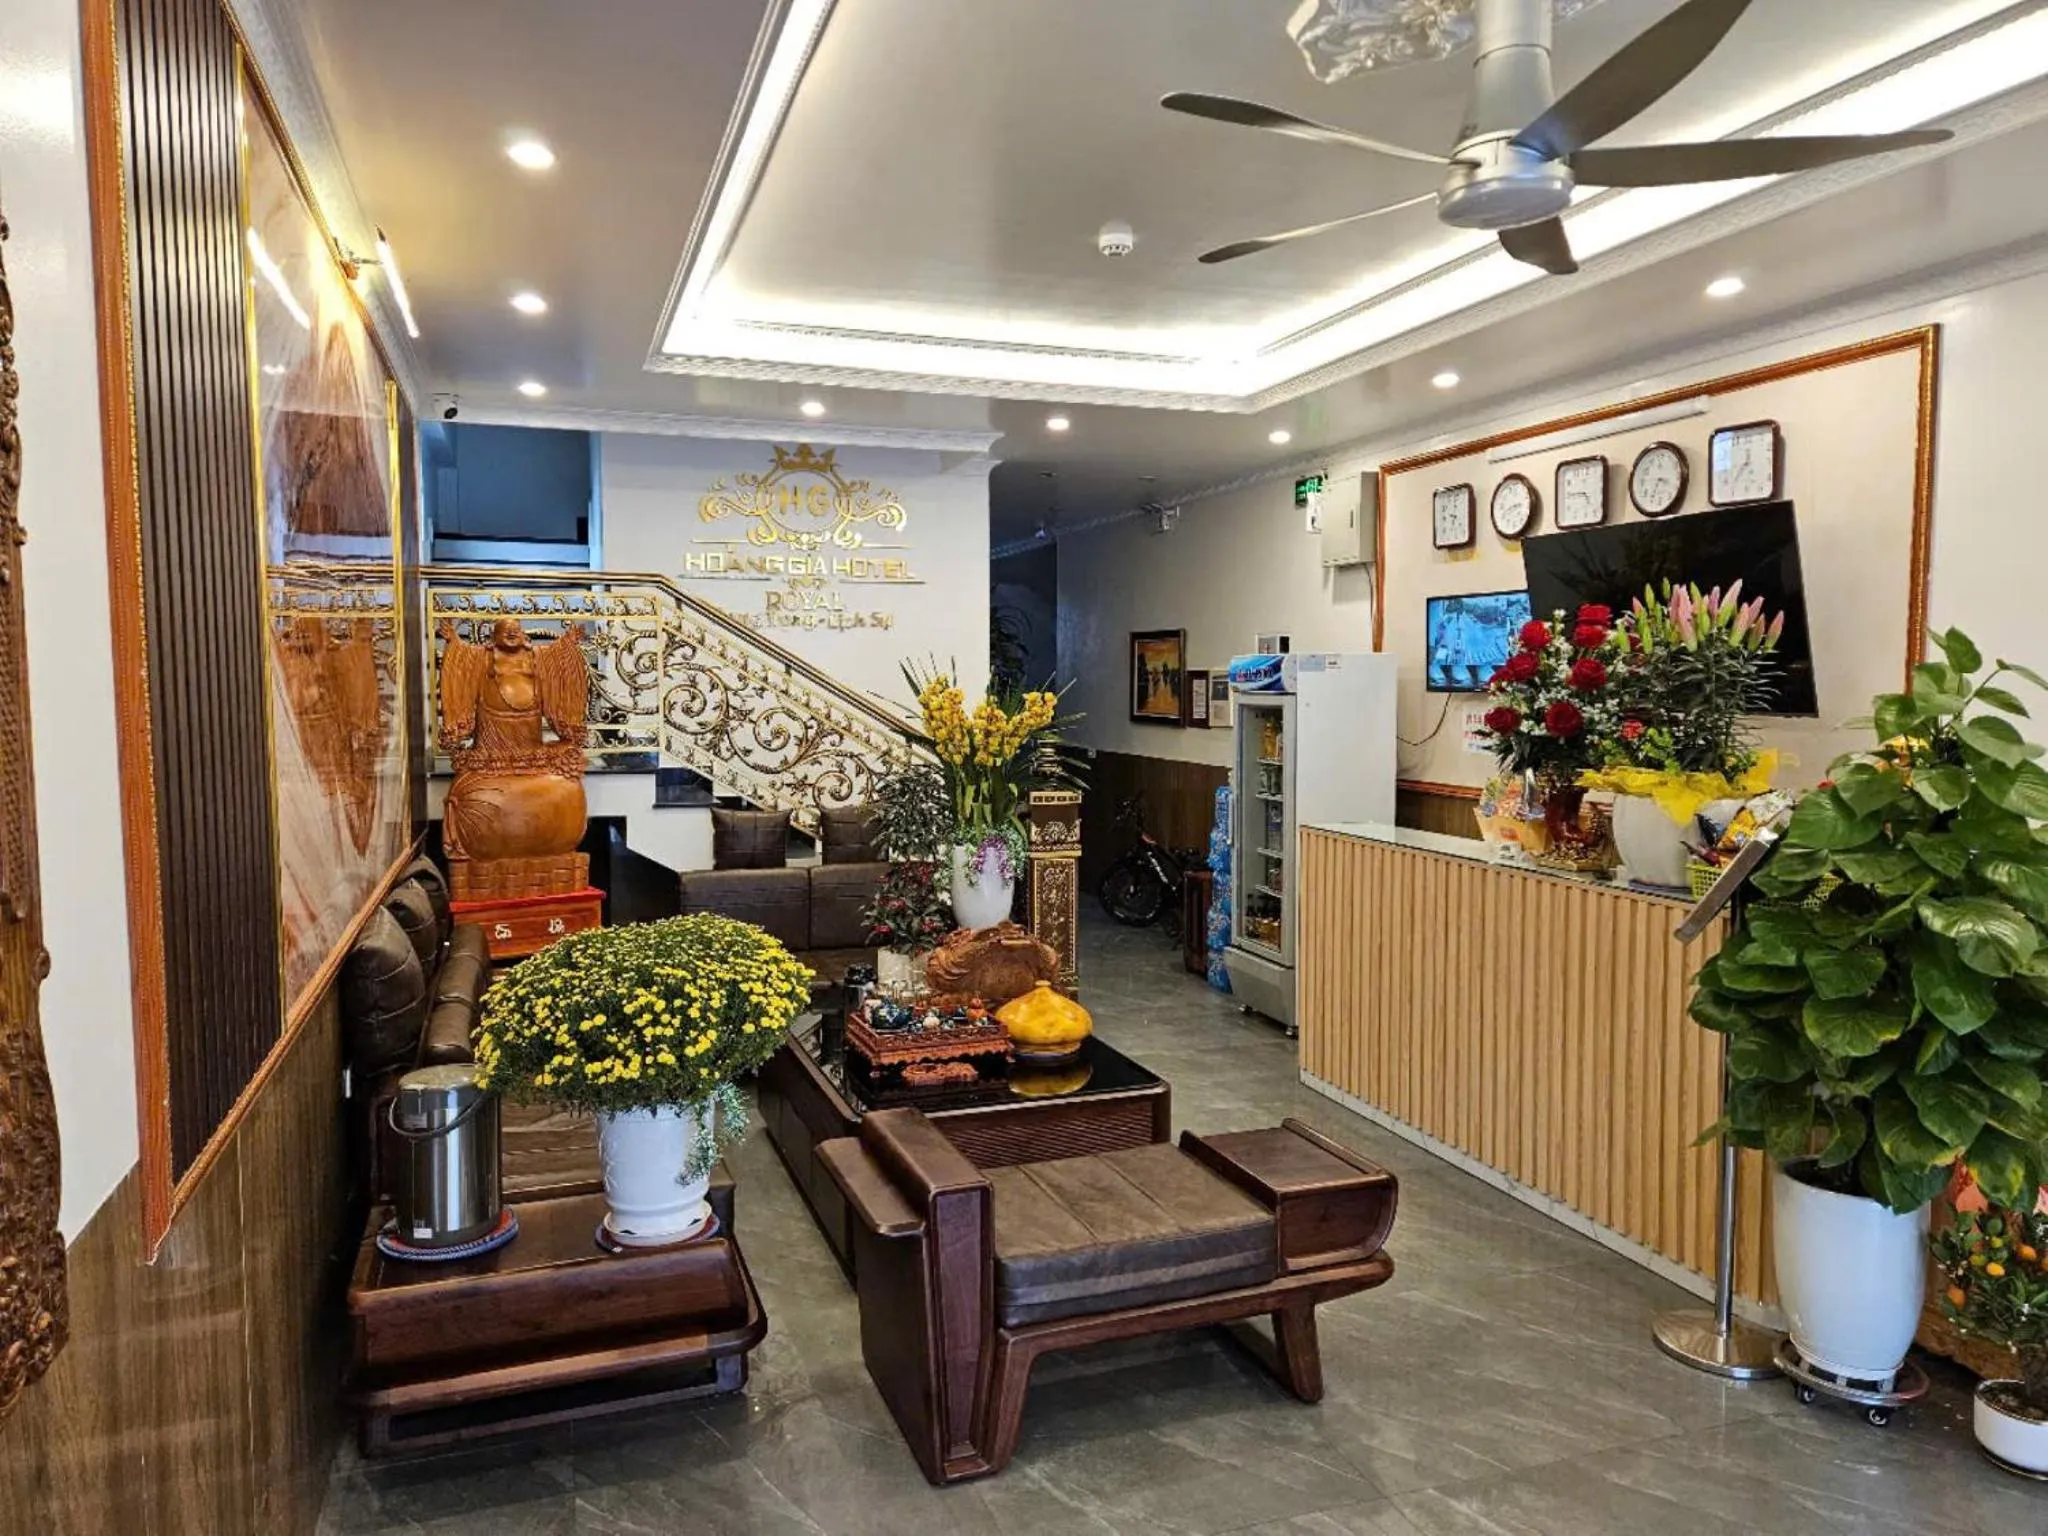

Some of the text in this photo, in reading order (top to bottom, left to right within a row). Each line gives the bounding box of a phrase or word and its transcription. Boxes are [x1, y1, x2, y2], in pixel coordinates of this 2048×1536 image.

[778, 484, 831, 517] HG
[787, 555, 828, 576] GIA
[832, 557, 917, 580] HOTEL
[765, 590, 847, 612] ROYAL
